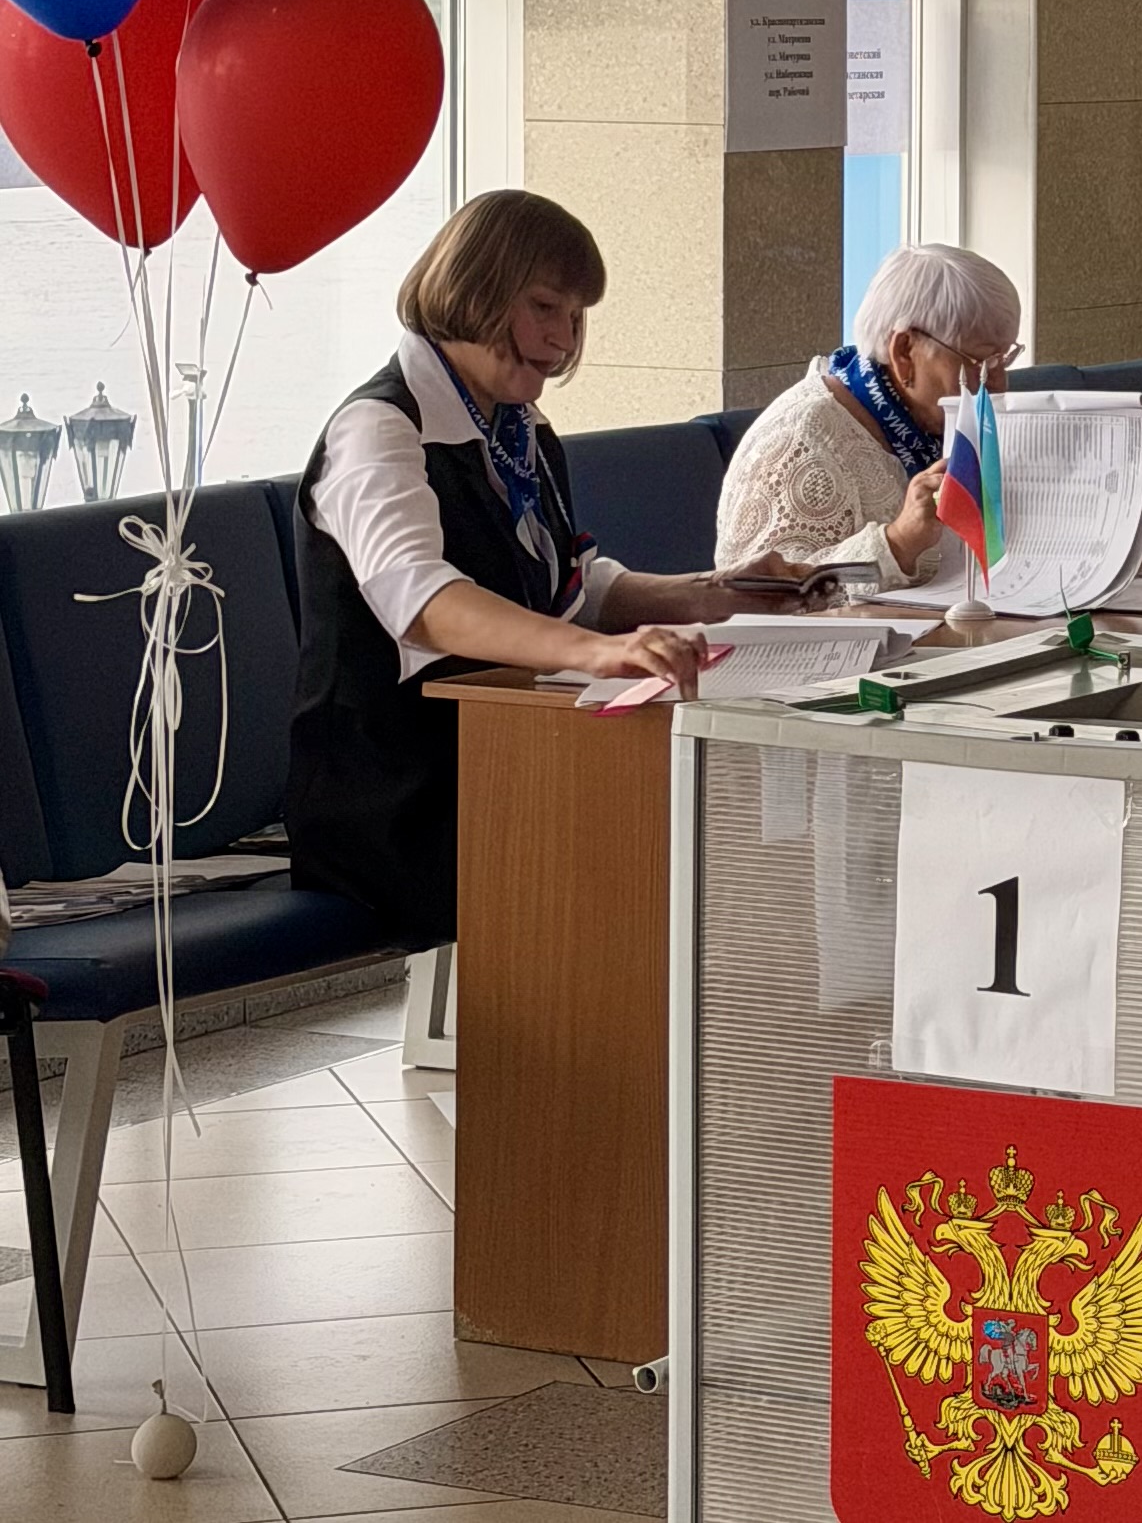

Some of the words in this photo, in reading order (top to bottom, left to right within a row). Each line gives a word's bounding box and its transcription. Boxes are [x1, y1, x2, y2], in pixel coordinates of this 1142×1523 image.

[864, 375, 888, 412] УИК
[883, 409, 913, 442] УИК
[976, 875, 1032, 998] 1
